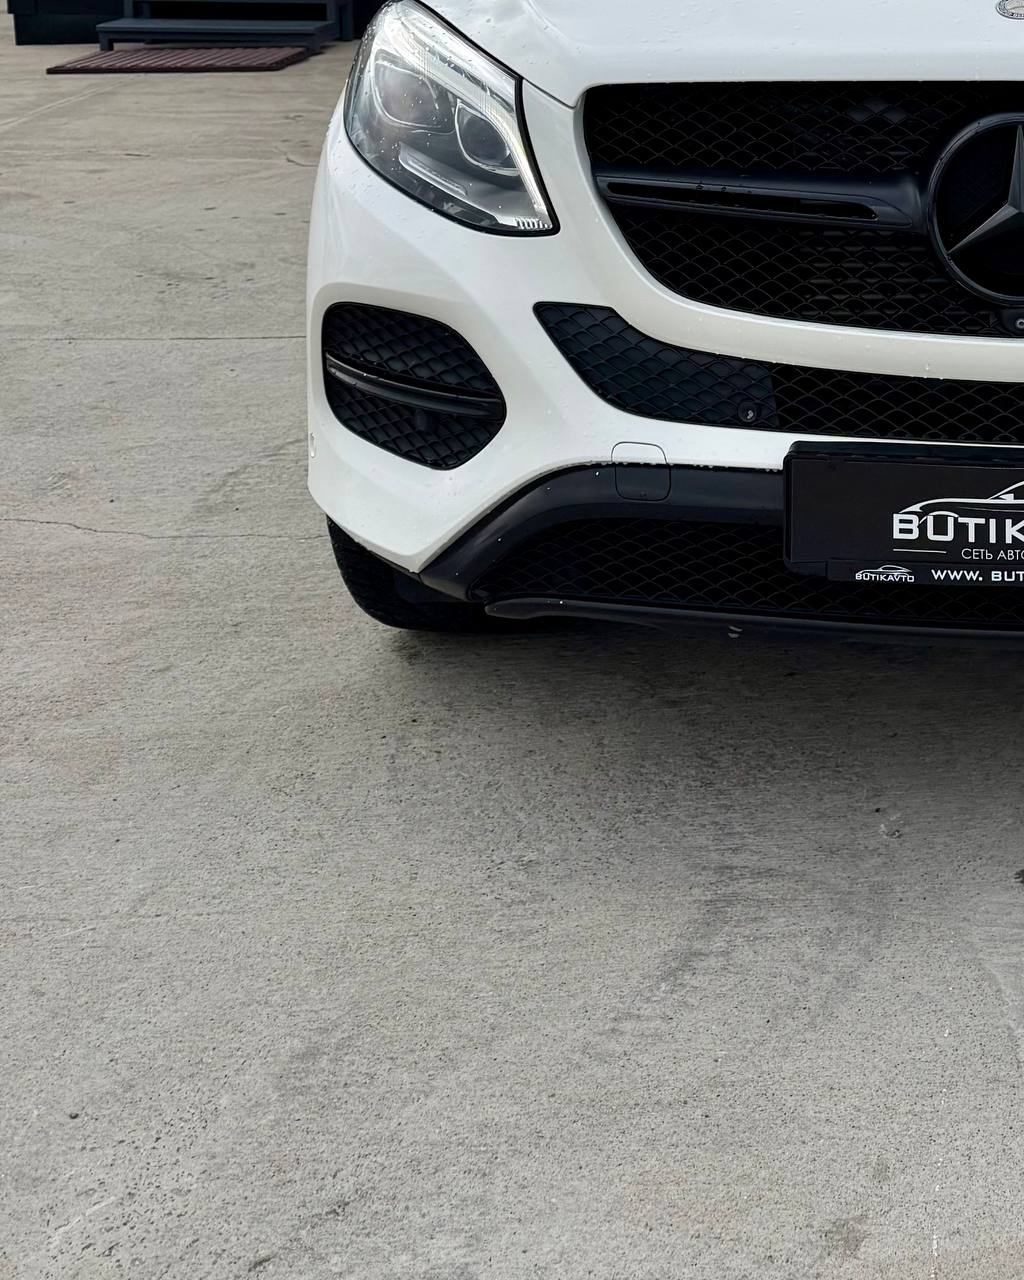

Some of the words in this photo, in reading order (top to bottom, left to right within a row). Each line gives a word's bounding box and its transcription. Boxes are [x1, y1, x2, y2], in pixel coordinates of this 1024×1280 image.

[961, 548, 994, 560] СЕТЬ
[855, 572, 915, 583] BUTIKAVTO
[931, 569, 984, 582] WWW.
